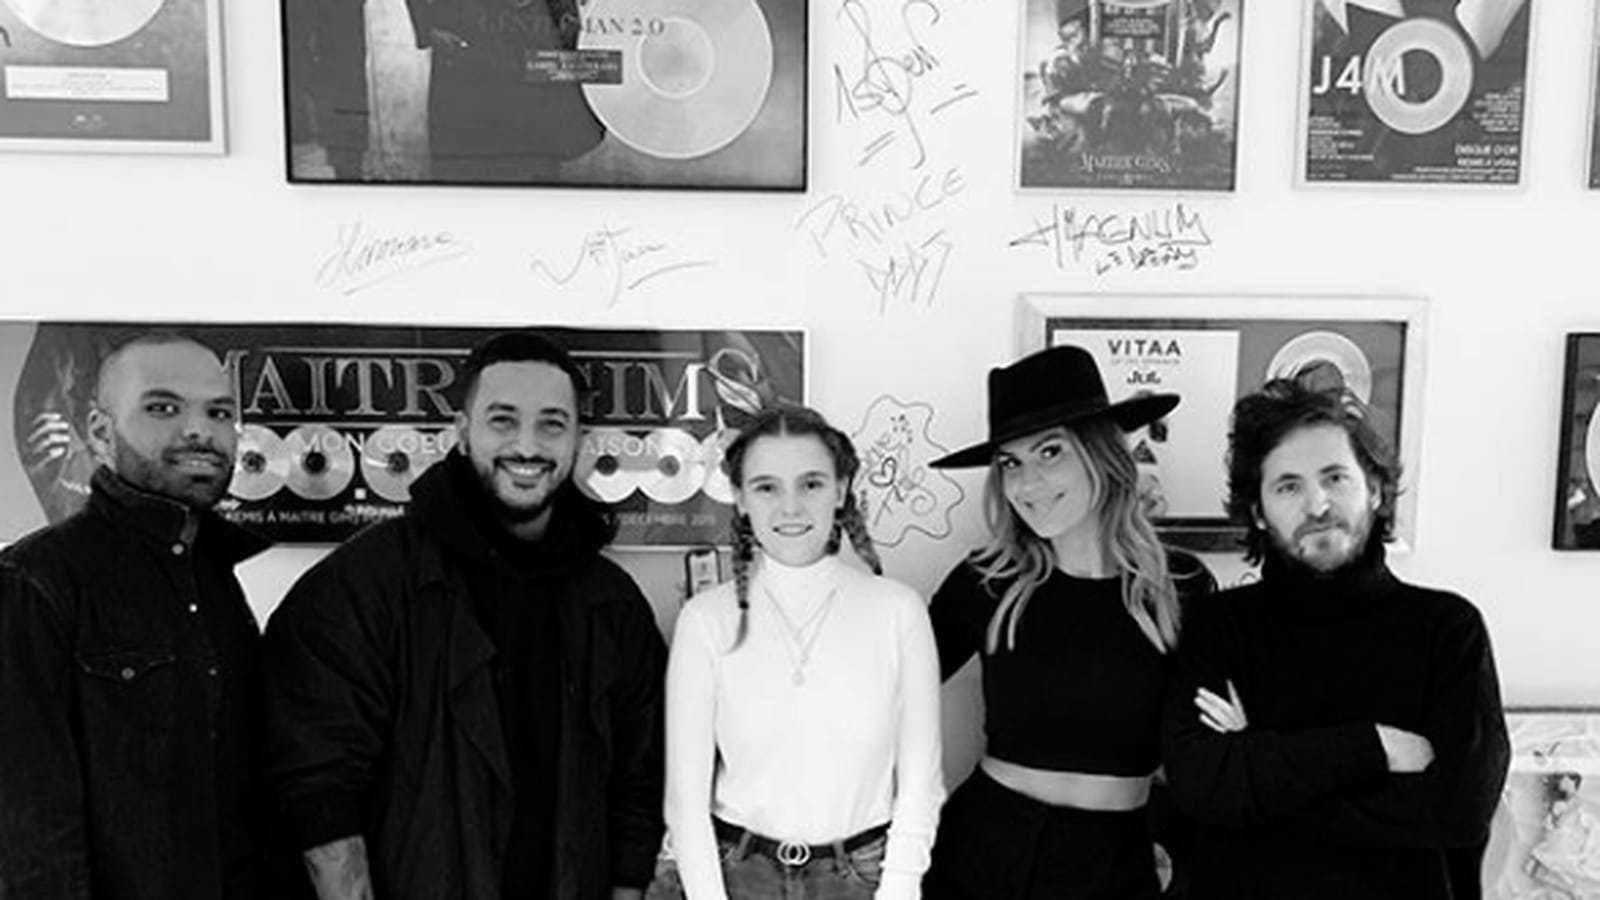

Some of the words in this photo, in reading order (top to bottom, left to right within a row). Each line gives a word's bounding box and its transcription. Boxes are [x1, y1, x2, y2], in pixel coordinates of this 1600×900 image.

[1312, 54, 1406, 95] J4M
[795, 168, 968, 258] PRINCE
[1107, 340, 1181, 356] VITAA
